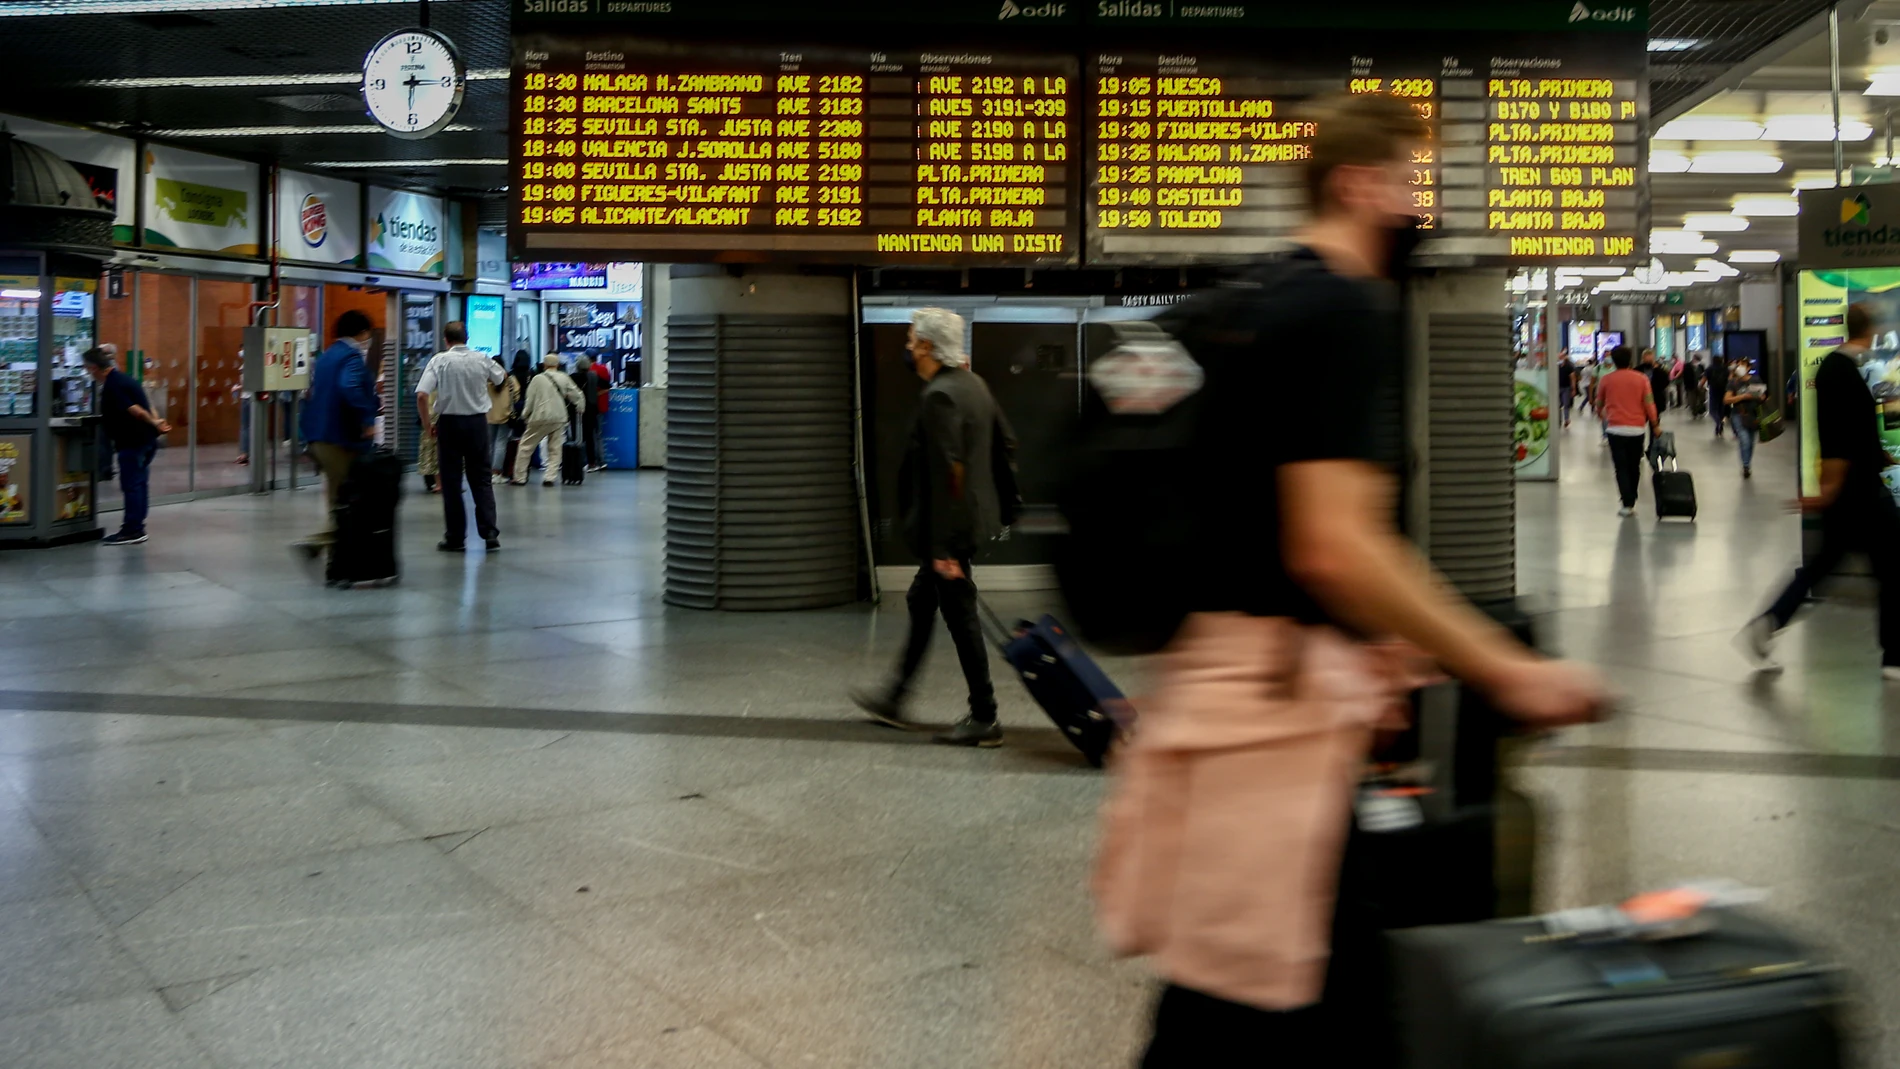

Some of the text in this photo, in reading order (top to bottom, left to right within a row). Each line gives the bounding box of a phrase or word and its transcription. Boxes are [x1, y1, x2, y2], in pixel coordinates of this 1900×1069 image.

[524, 0, 672, 12] Salidas DEPARTURES
[1022, 2, 1066, 17] adif
[1098, 0, 1245, 18] Salidas DEPARTURES
[1592, 6, 1636, 22] adif
[405, 42, 422, 54] 12
[525, 50, 549, 60] Hora
[585, 50, 625, 61] Destino
[780, 52, 802, 62] Tren
[920, 53, 992, 64] Observaciones
[1098, 54, 1122, 65] Hora
[1158, 54, 1196, 66] Destino
[1351, 56, 1374, 67] Tren
[1490, 57, 1561, 68] Observaciones
[375, 79, 386, 91] 9
[524, 73, 577, 91] 18:30
[583, 74, 648, 91] MALAGA
[777, 75, 810, 92] AVE
[818, 75, 863, 92] 2182
[929, 77, 963, 94] AVE
[971, 77, 1014, 94] 2192
[1024, 77, 1035, 94] A
[1044, 77, 1066, 94] LA
[1098, 77, 1151, 95] 19:05
[1157, 78, 1221, 95] HUESCA
[1350, 79, 1382, 93] AVE
[1489, 79, 1614, 98] PLTA.PRIMERA
[524, 95, 1066, 116] 18:30 BARCELONA SANTS AVE 3183 AVES 3191-339
[1098, 99, 1151, 117] 19:15
[1157, 100, 1273, 118] PUERTOLLANO
[1549, 102, 1561, 119] Y
[408, 113, 418, 125] 6
[524, 117, 1066, 138] 18:35 SEVILLA STA. JUSTA AVE 2380 AVE 2190 A LA
[1098, 121, 1151, 139] 19:30
[1489, 123, 1614, 141] PLTA.PRIMERA
[523, 139, 1066, 161] 18:40 VALENCIA J.SOROLLA AVE 5180 AVE 5198 A LA
[1098, 143, 1151, 161] 19:35
[1157, 144, 1221, 162] MALAGA
[1489, 145, 1614, 164] PLTA.PRIMERA
[523, 161, 1045, 183] 19:00 SEVILLA STA. JUSTA AVE 2190 PLTA.PRIMERA
[1098, 165, 1151, 183] 19:35
[1157, 166, 1243, 184] PAMPLONA
[1500, 167, 1541, 185] TREN
[1549, 167, 1583, 185] 609
[523, 184, 1045, 205] 19:00 FIGUERES-VILAFANT AVE 3191 PLTA.PRIMERA
[1098, 187, 1151, 205] 19:40
[1157, 188, 1243, 206] CASTELLO
[1489, 189, 1553, 207] PLANTA
[1561, 189, 1605, 207] BAJA
[303, 213, 326, 235] KING
[522, 206, 1034, 227] 19:05 ALICANTE/ALACANT AVE 5192 PLANTA BAJA
[1098, 209, 1605, 229] 19:50 TOLEDO PLANTA BAJA
[389, 216, 437, 242] tiendas
[877, 234, 962, 252] MANTENGA
[972, 235, 1005, 252] UNA
[1511, 237, 1595, 255] MANTENGA
[568, 276, 605, 288] MADRID
[1121, 294, 1197, 307] TASTY DAILY FO
[565, 327, 607, 348] Sevilla
